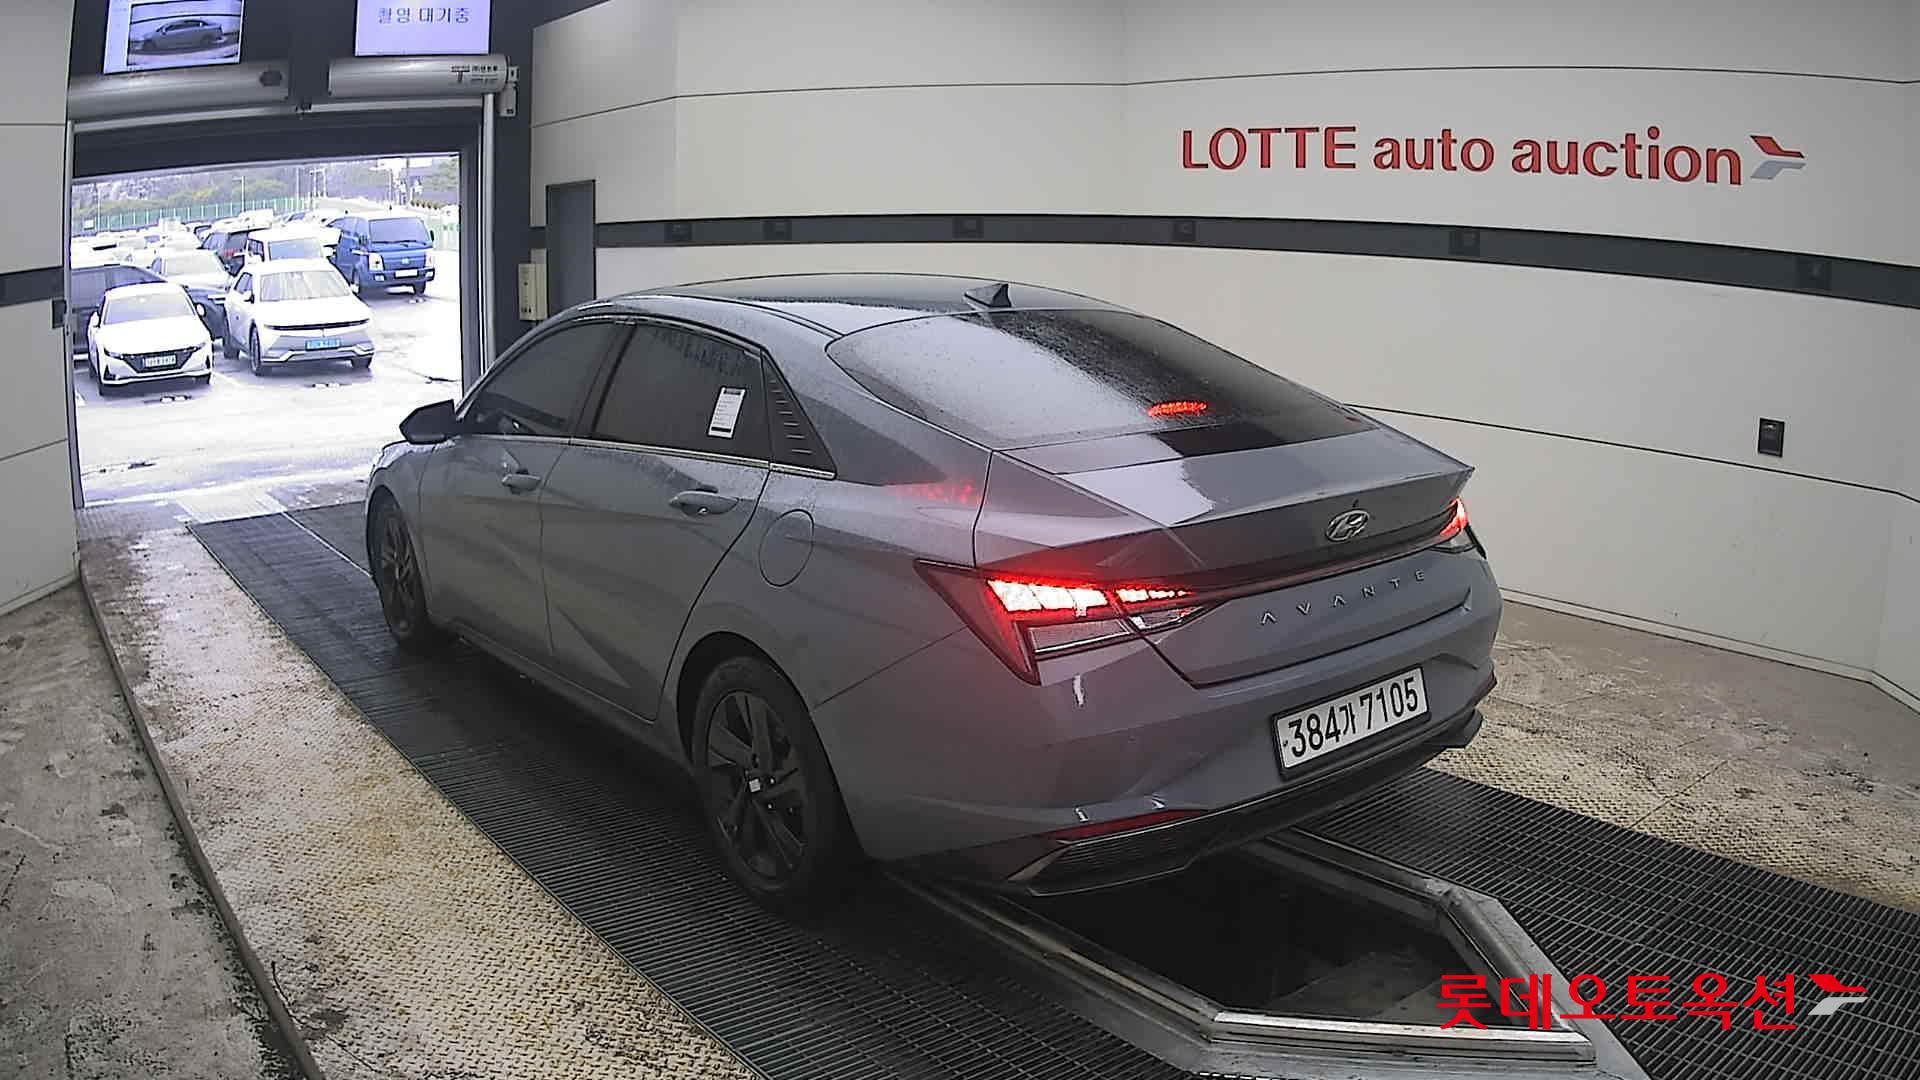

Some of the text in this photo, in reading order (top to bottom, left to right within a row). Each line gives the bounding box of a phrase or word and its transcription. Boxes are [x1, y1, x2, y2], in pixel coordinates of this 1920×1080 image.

[418, 7, 470, 24] 대기중
[1181, 126, 1743, 186] LOTTE auto auction
[1260, 568, 1426, 625] AVANTE
[1287, 676, 1418, 758] 384가 7105
